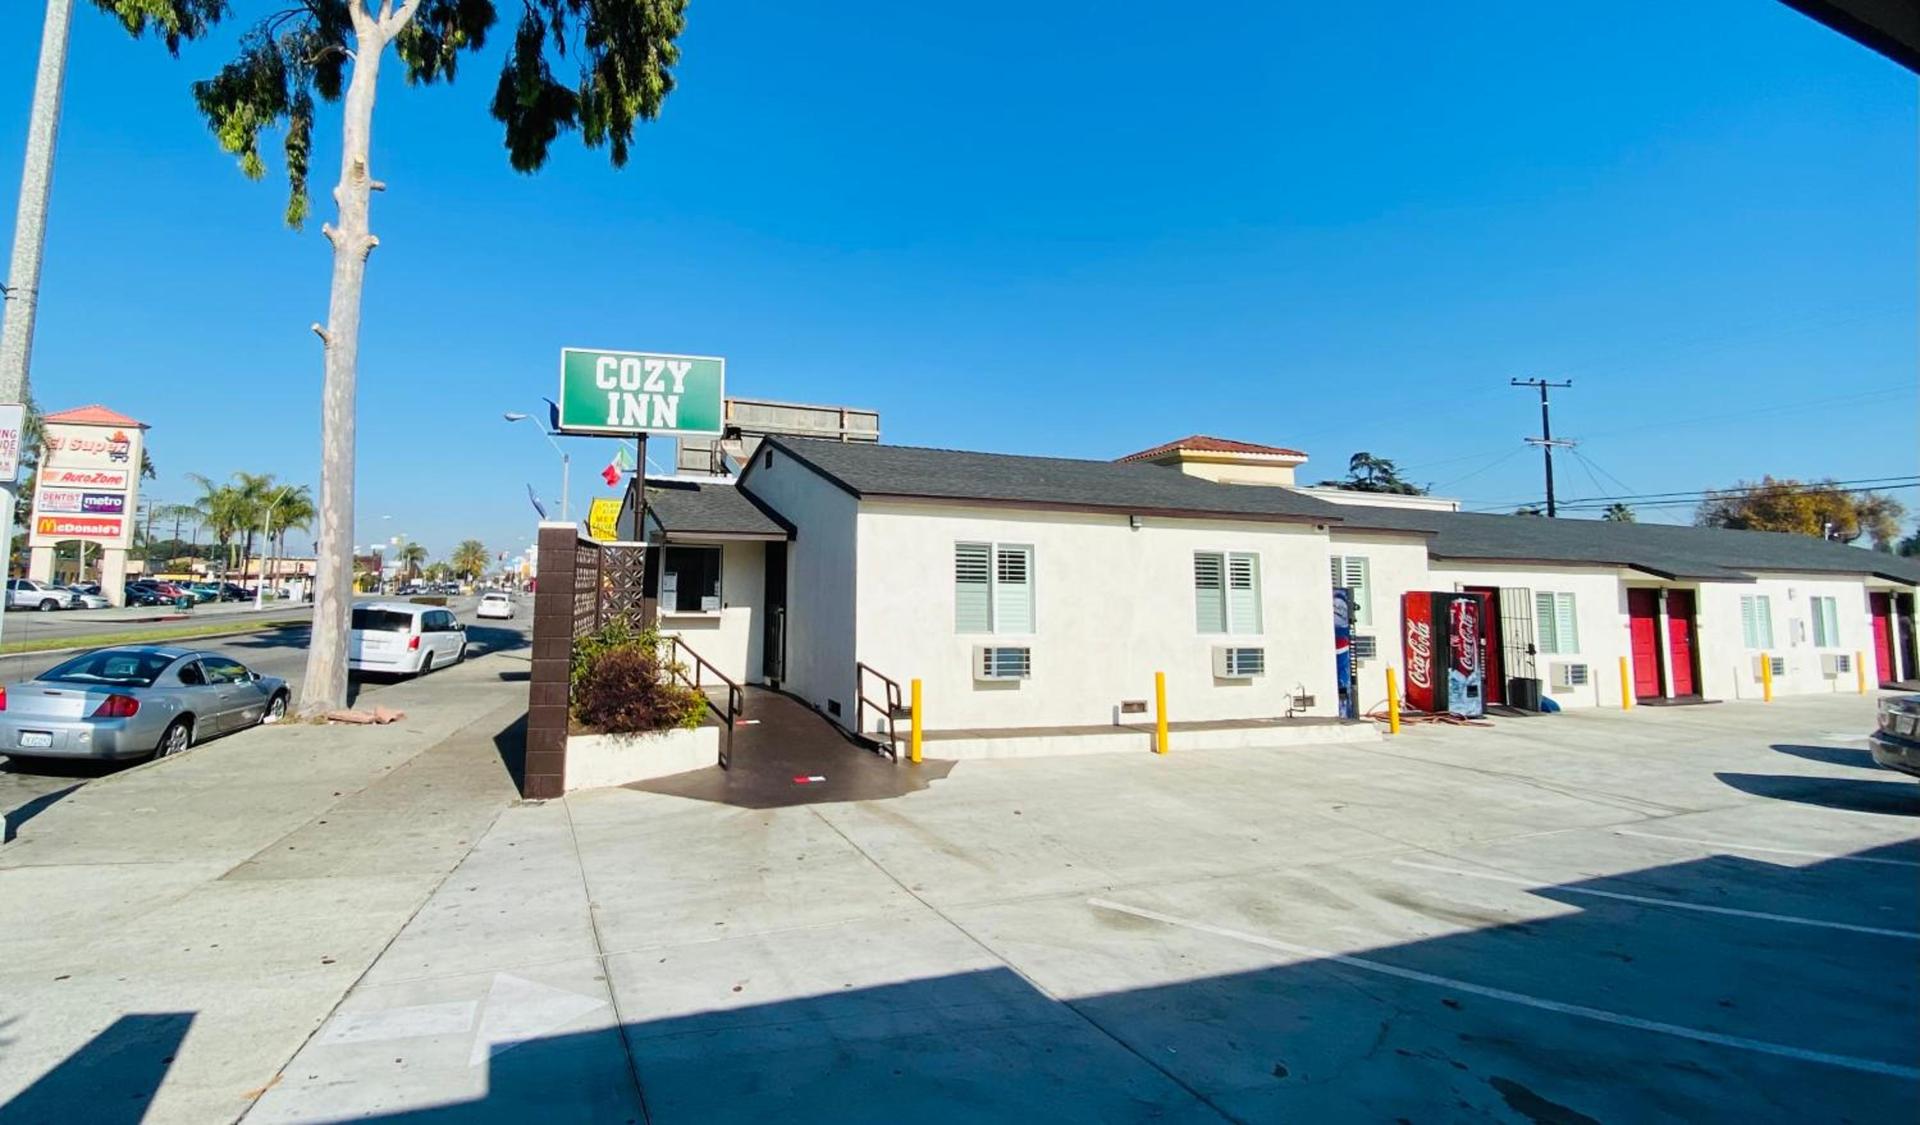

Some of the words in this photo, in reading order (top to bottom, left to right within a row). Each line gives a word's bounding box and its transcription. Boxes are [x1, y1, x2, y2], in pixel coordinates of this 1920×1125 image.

[596, 356, 692, 394] COZY
[607, 391, 679, 428] INN
[70, 438, 125, 455] Super
[61, 471, 123, 485] AutoZone
[43, 492, 80, 501] DENTIST
[83, 495, 122, 507] metro
[39, 518, 119, 535] McDonald's
